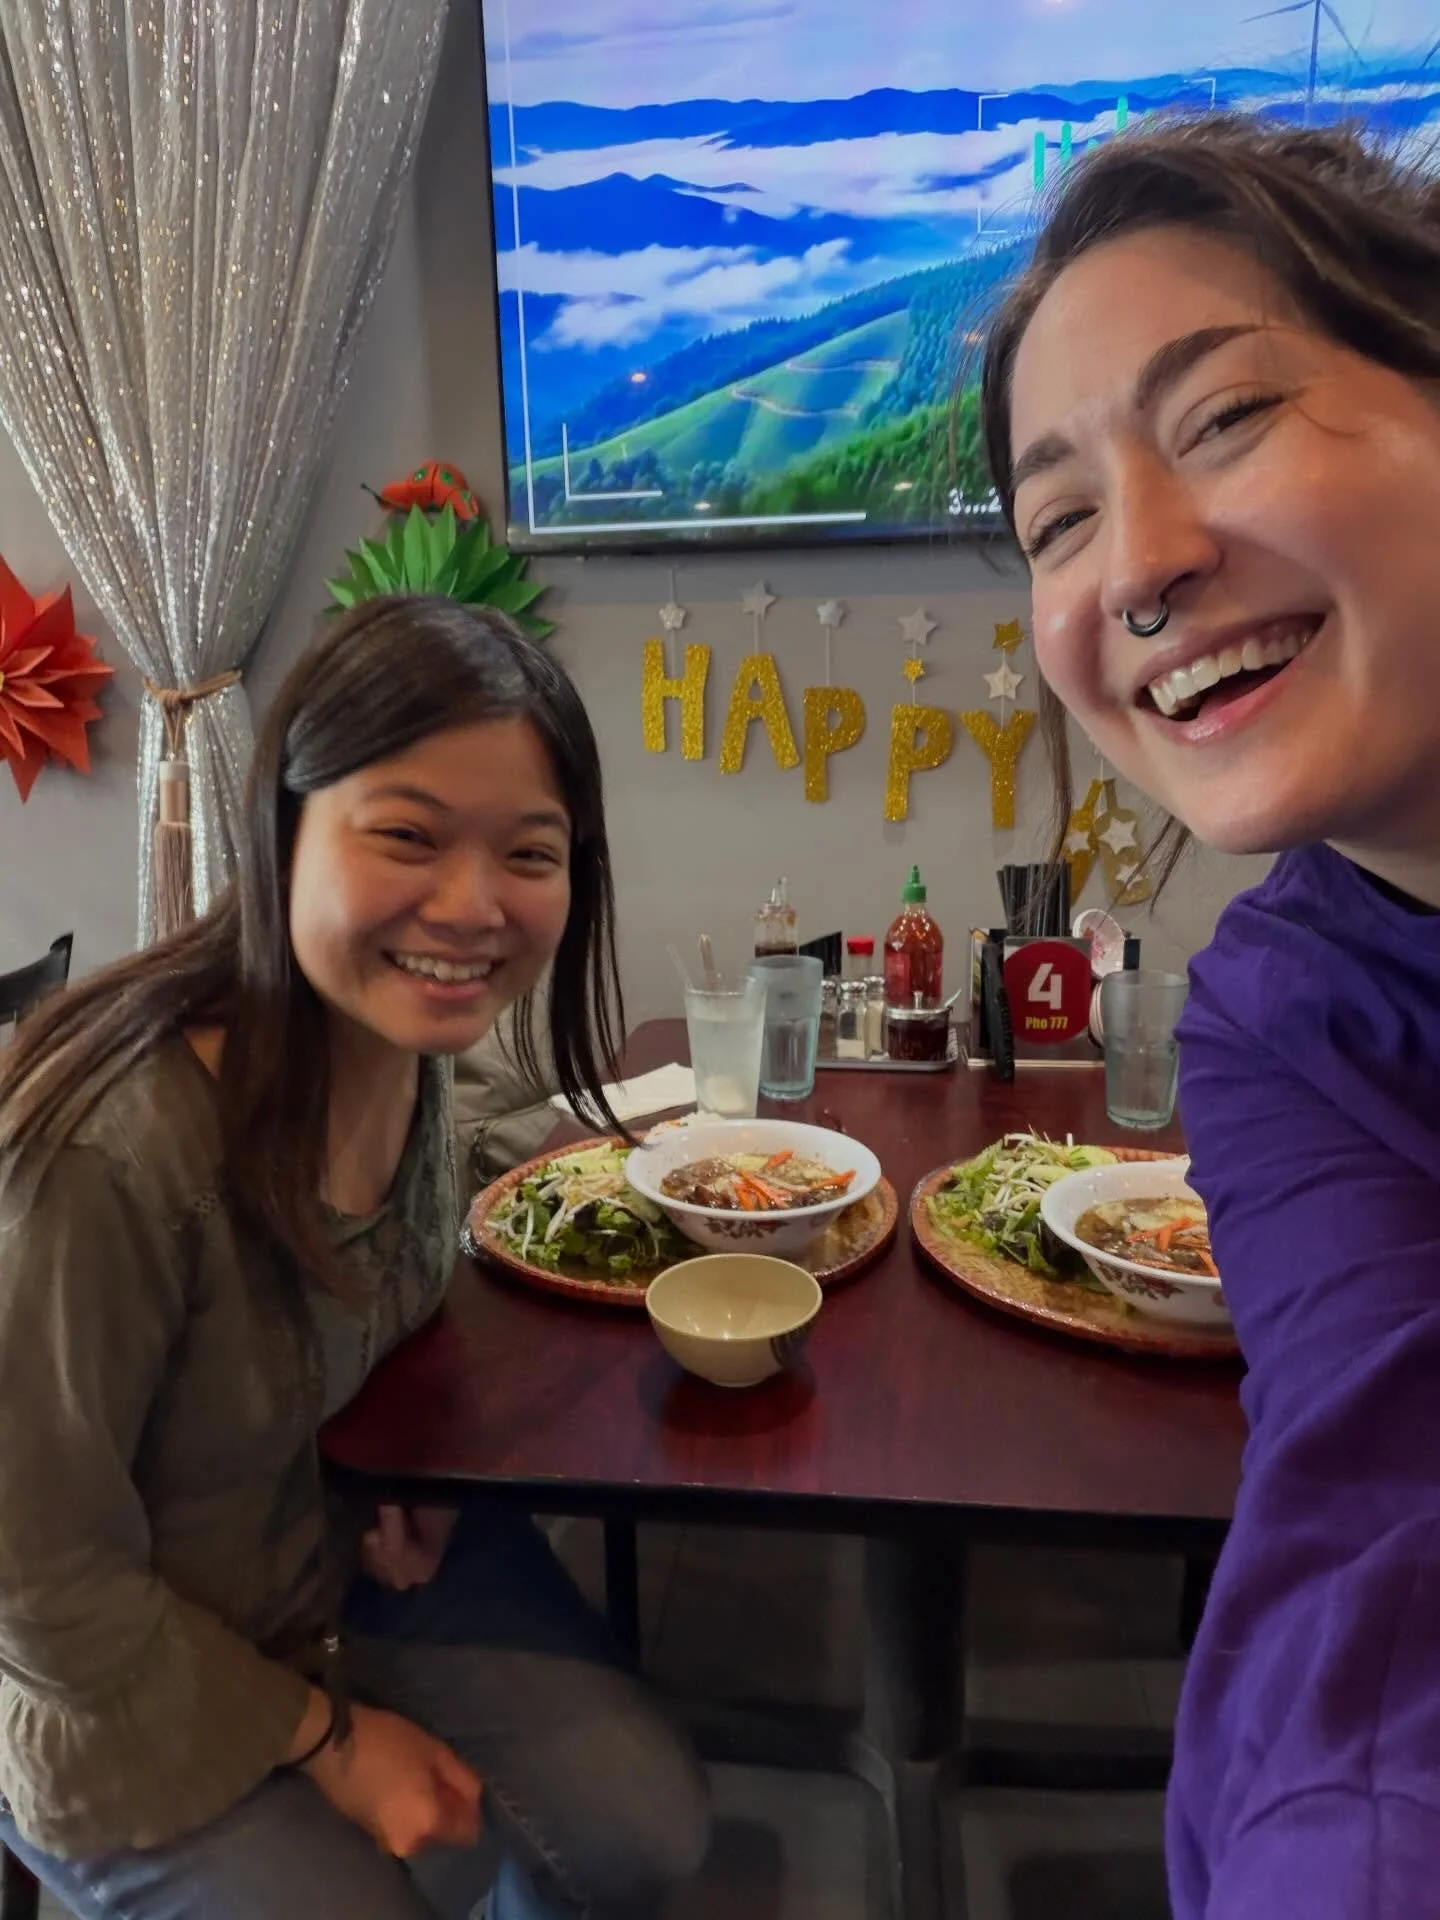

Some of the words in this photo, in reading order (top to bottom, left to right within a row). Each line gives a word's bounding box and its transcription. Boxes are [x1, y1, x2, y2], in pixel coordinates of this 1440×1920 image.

[640, 638, 1037, 830] HAPPY
[1027, 963, 1062, 1010] 4
[1025, 1016, 1048, 1030] Pho
[1050, 1016, 1068, 1030] 777
